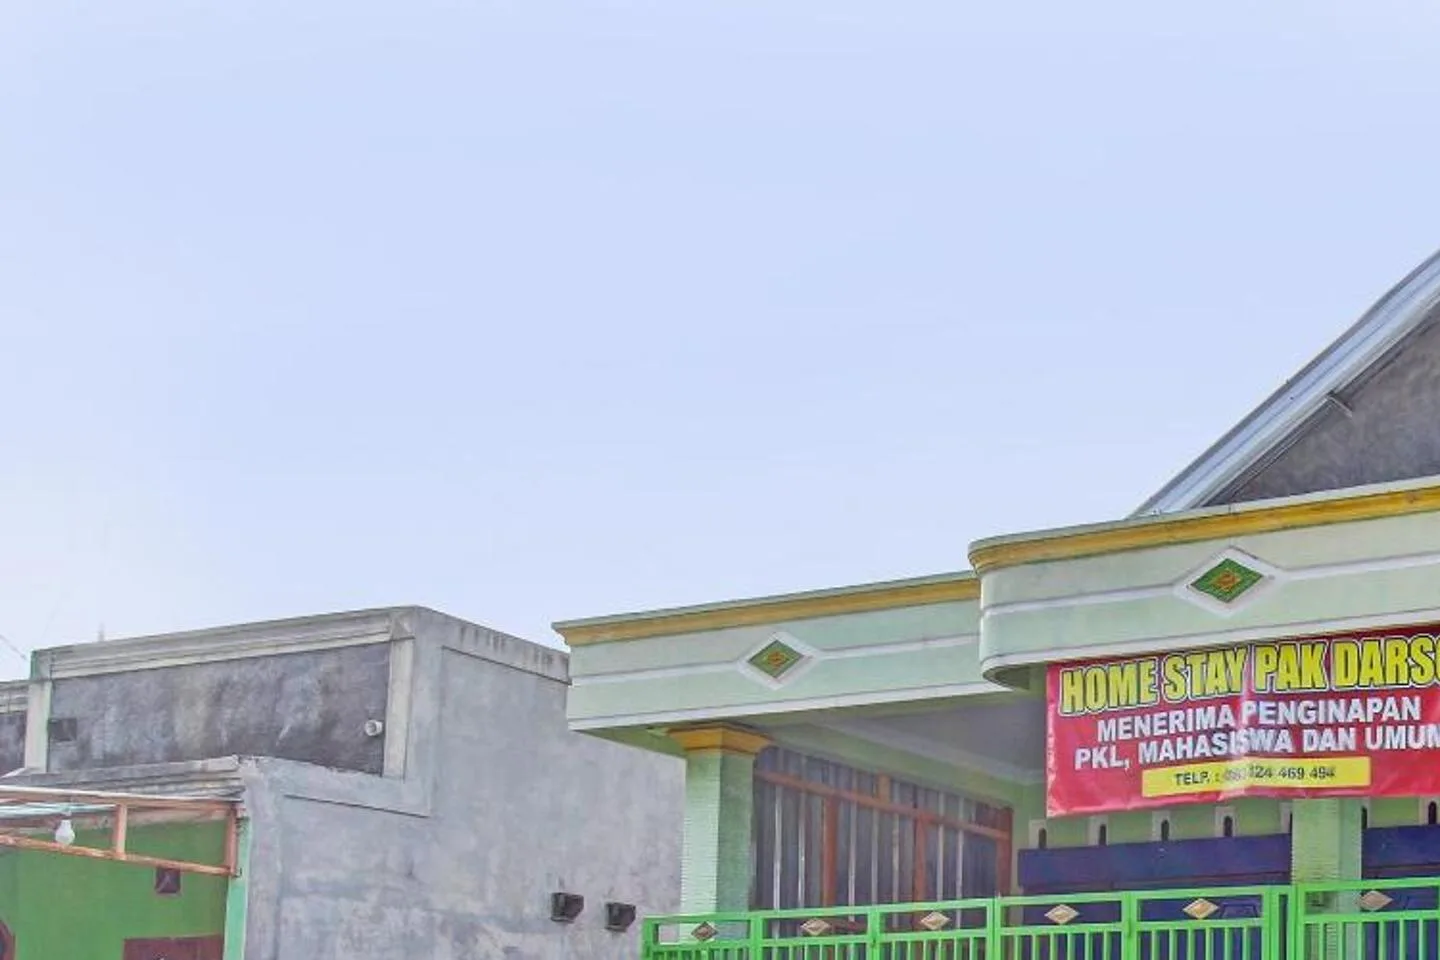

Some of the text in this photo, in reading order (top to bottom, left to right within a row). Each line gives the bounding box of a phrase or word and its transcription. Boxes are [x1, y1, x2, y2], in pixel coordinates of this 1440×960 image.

[1058, 656, 1160, 717] HOME
[1162, 647, 1247, 702] STAY
[1252, 639, 1328, 693] PAK
[1097, 696, 1421, 743] MENERIMA PENGINAPAN
[1074, 744, 1131, 771] PKL,
[1138, 729, 1294, 765] MAHASISWA
[1303, 726, 1356, 751] DAN
[1174, 771, 1211, 786] TELP.
